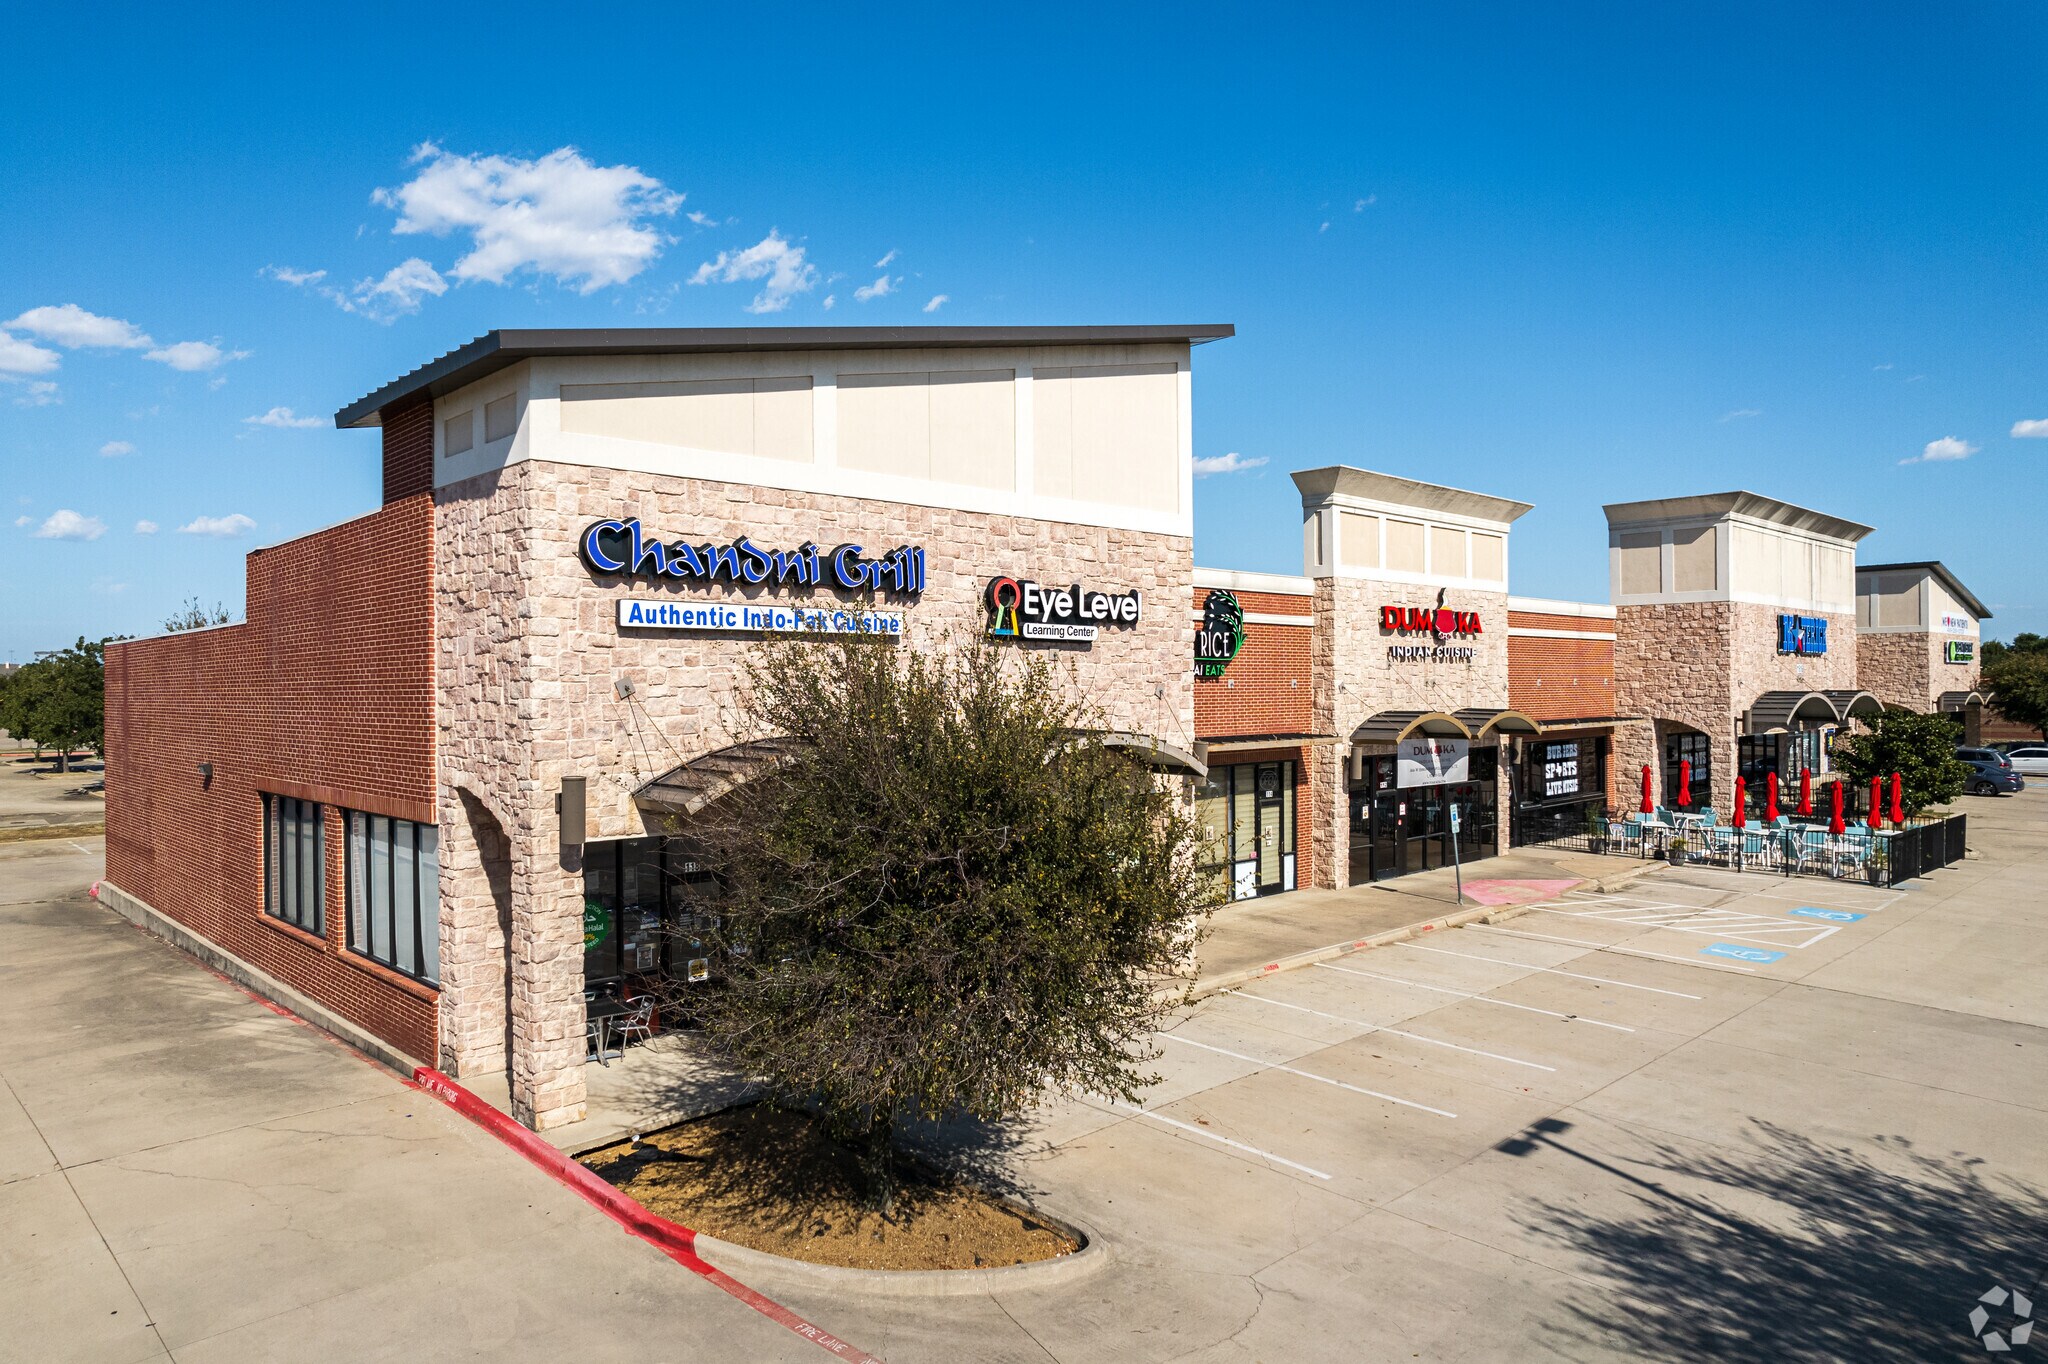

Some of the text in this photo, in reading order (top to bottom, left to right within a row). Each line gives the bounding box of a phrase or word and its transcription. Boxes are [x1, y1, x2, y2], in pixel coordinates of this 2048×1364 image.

[585, 516, 926, 594] Chandni Grill
[628, 602, 737, 627] Authentic
[1024, 583, 1142, 623] Eye Level
[1026, 624, 1095, 639] Learning Center
[1200, 631, 1230, 657] RICE
[1392, 646, 1477, 657] INDIAN CUISINE
[1205, 664, 1226, 676] EATS
[588, 923, 605, 932] Halal
[794, 1322, 849, 1353] FIRE LANE
